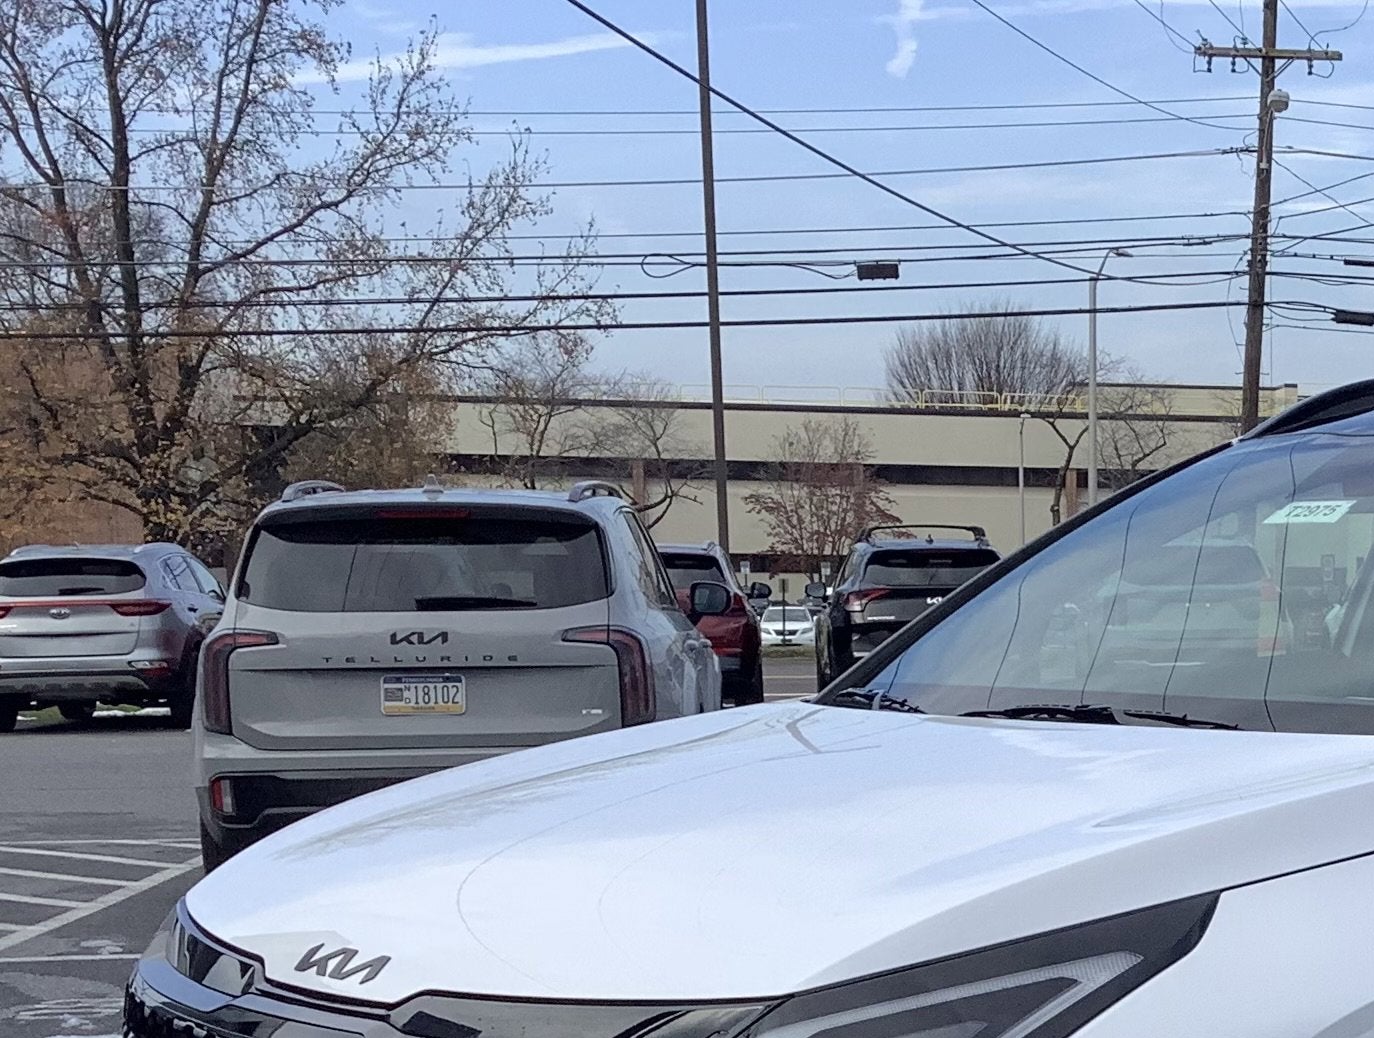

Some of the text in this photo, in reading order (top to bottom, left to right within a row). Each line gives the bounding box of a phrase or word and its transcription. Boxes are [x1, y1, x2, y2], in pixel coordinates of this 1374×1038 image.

[389, 631, 449, 645] KIA
[323, 654, 518, 663] TELLURIDE
[414, 684, 460, 704] 18102
[294, 942, 392, 985] KIA
